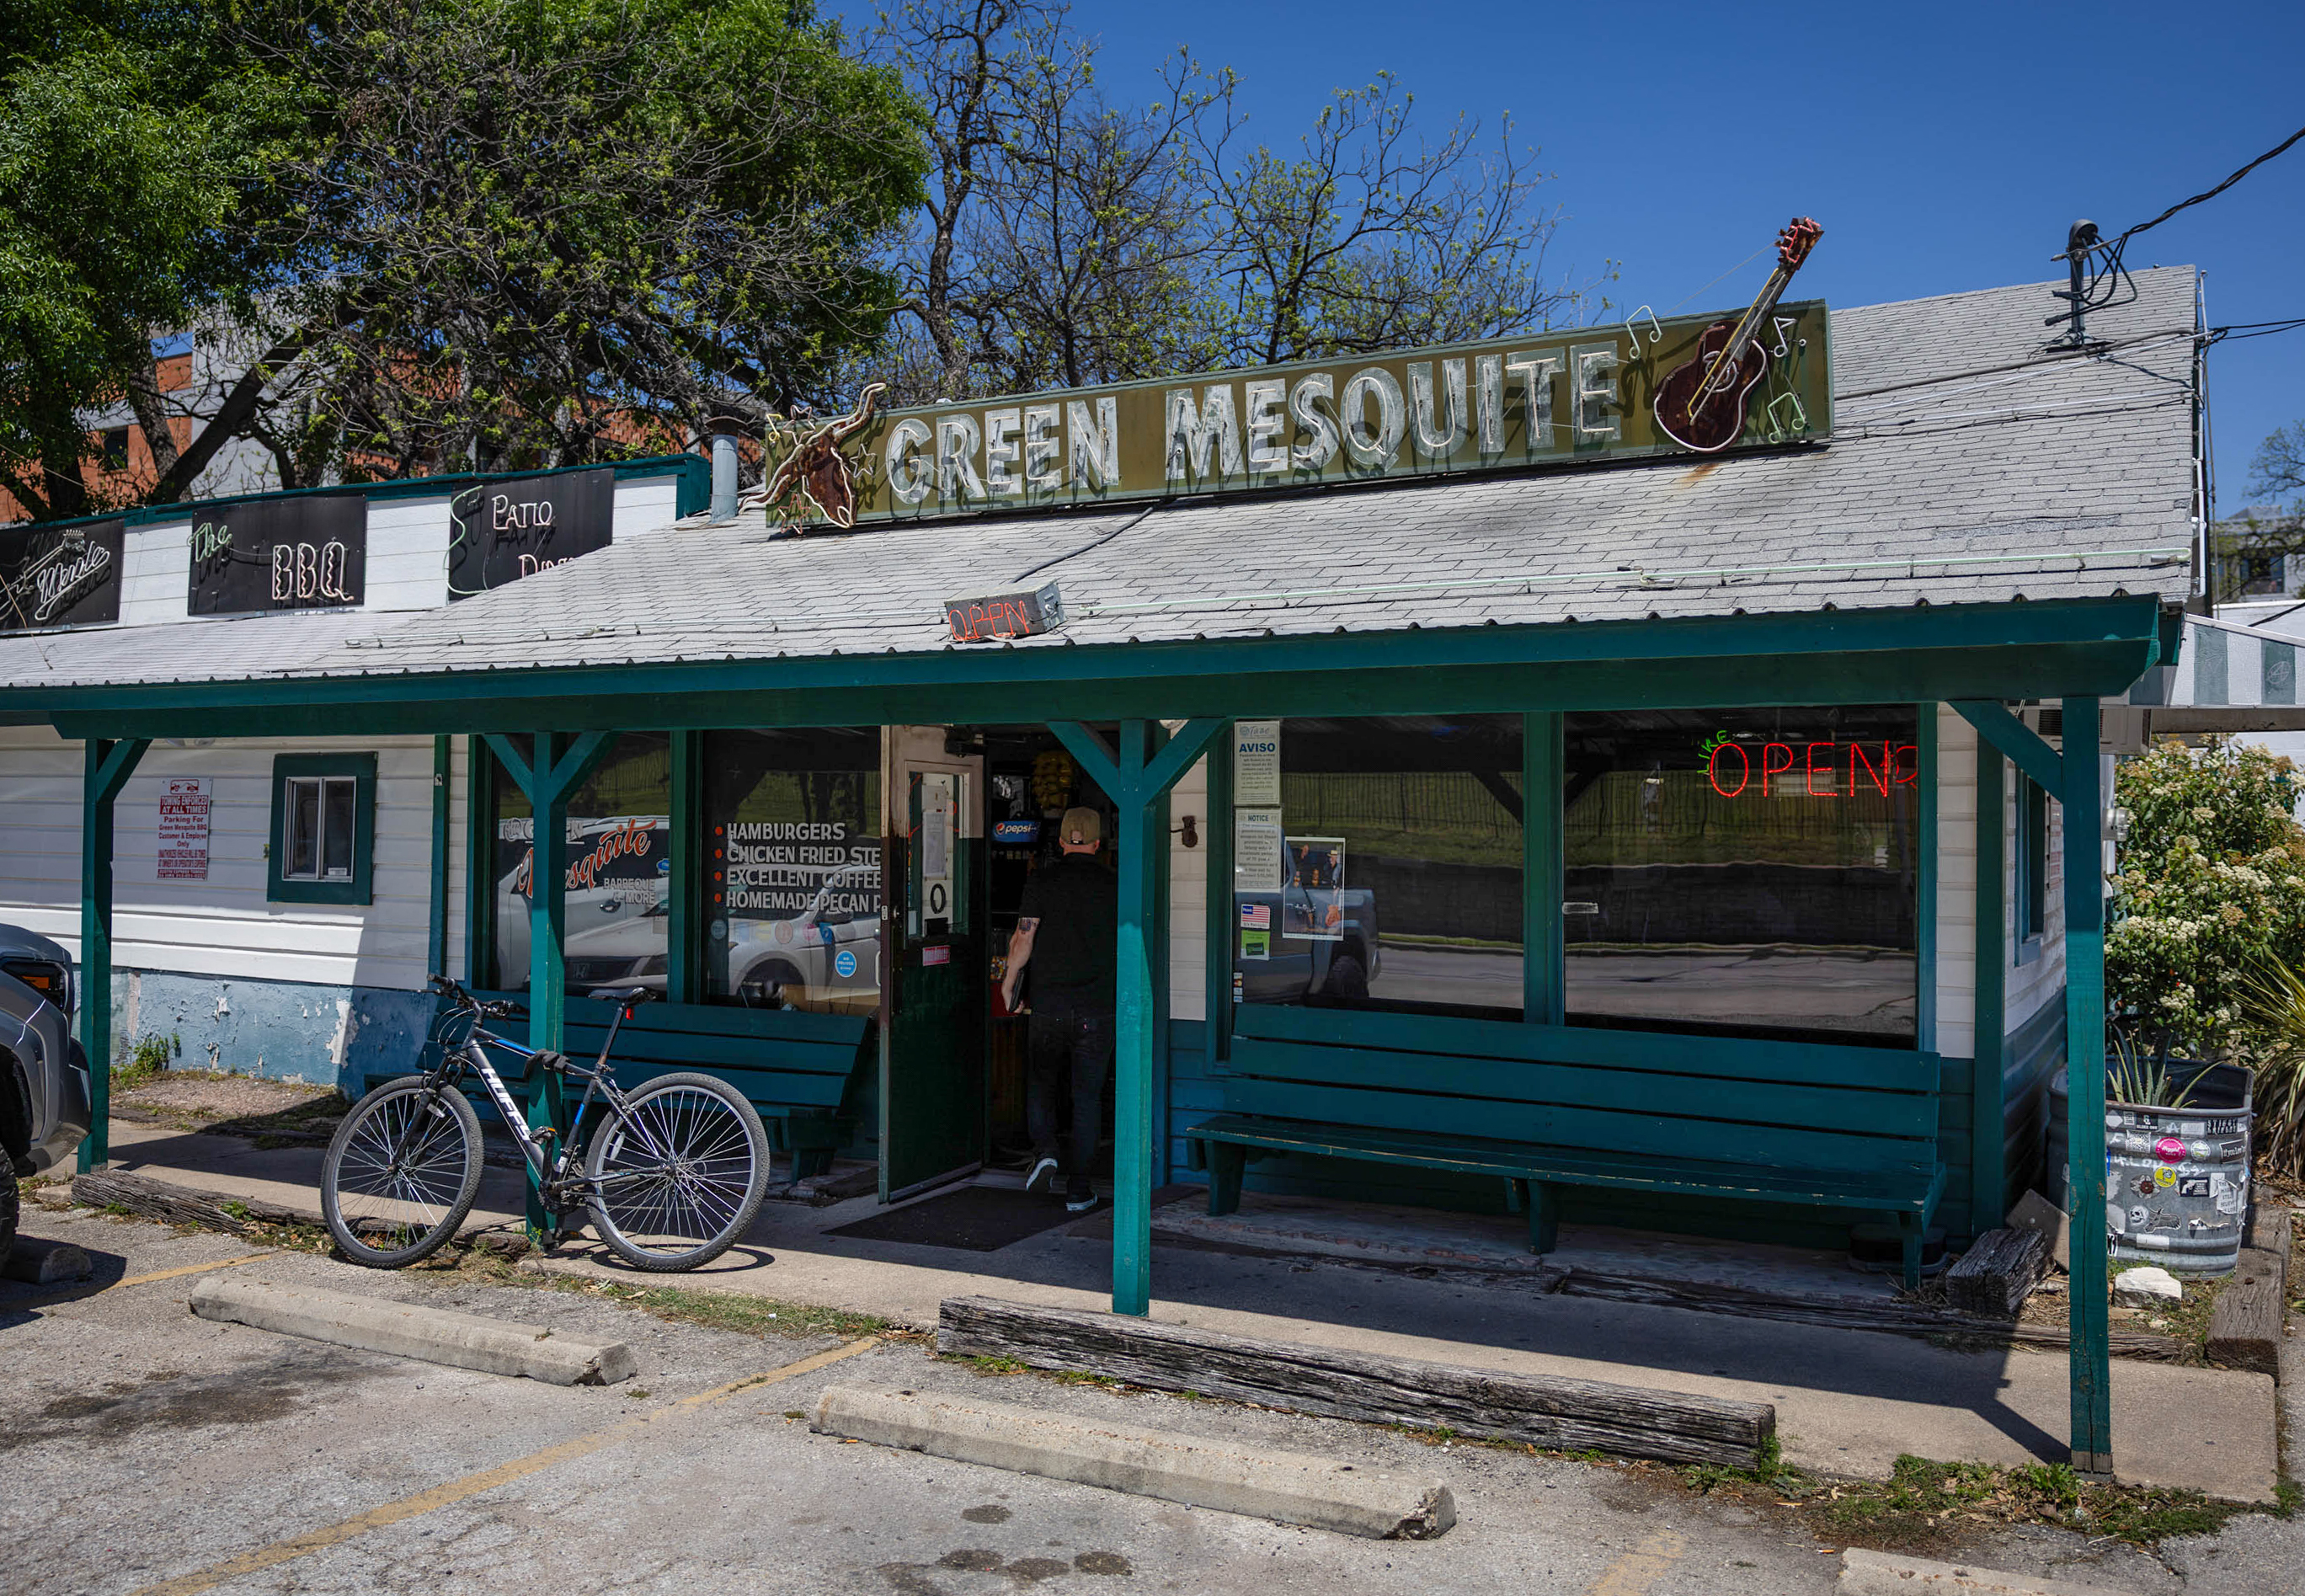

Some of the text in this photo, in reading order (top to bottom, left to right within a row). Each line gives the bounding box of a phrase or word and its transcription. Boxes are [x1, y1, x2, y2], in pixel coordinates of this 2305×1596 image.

[886, 340, 1621, 504] GREEN MESQUITE
[188, 522, 232, 563] The
[272, 541, 355, 601] BBQ
[948, 600, 1030, 642] OPEN
[1239, 742, 1276, 753] AVISO
[1710, 740, 1890, 798] OPEN
[161, 797, 208, 805] TOWING ENFORCED
[162, 805, 207, 814] AT ALL TIMES
[727, 822, 846, 841] HAMBURGERS
[1005, 823, 1032, 835] pepsi
[727, 846, 795, 864] CHICKEN
[800, 846, 846, 865] FRIED
[603, 878, 656, 891] BARBEQUE
[727, 868, 881, 889] EXCELLENT COFFEE
[625, 891, 656, 905] MORE
[726, 891, 817, 910] HOMEMADE
[819, 893, 869, 912] PECAN
[481, 1068, 531, 1141] HUFFY
